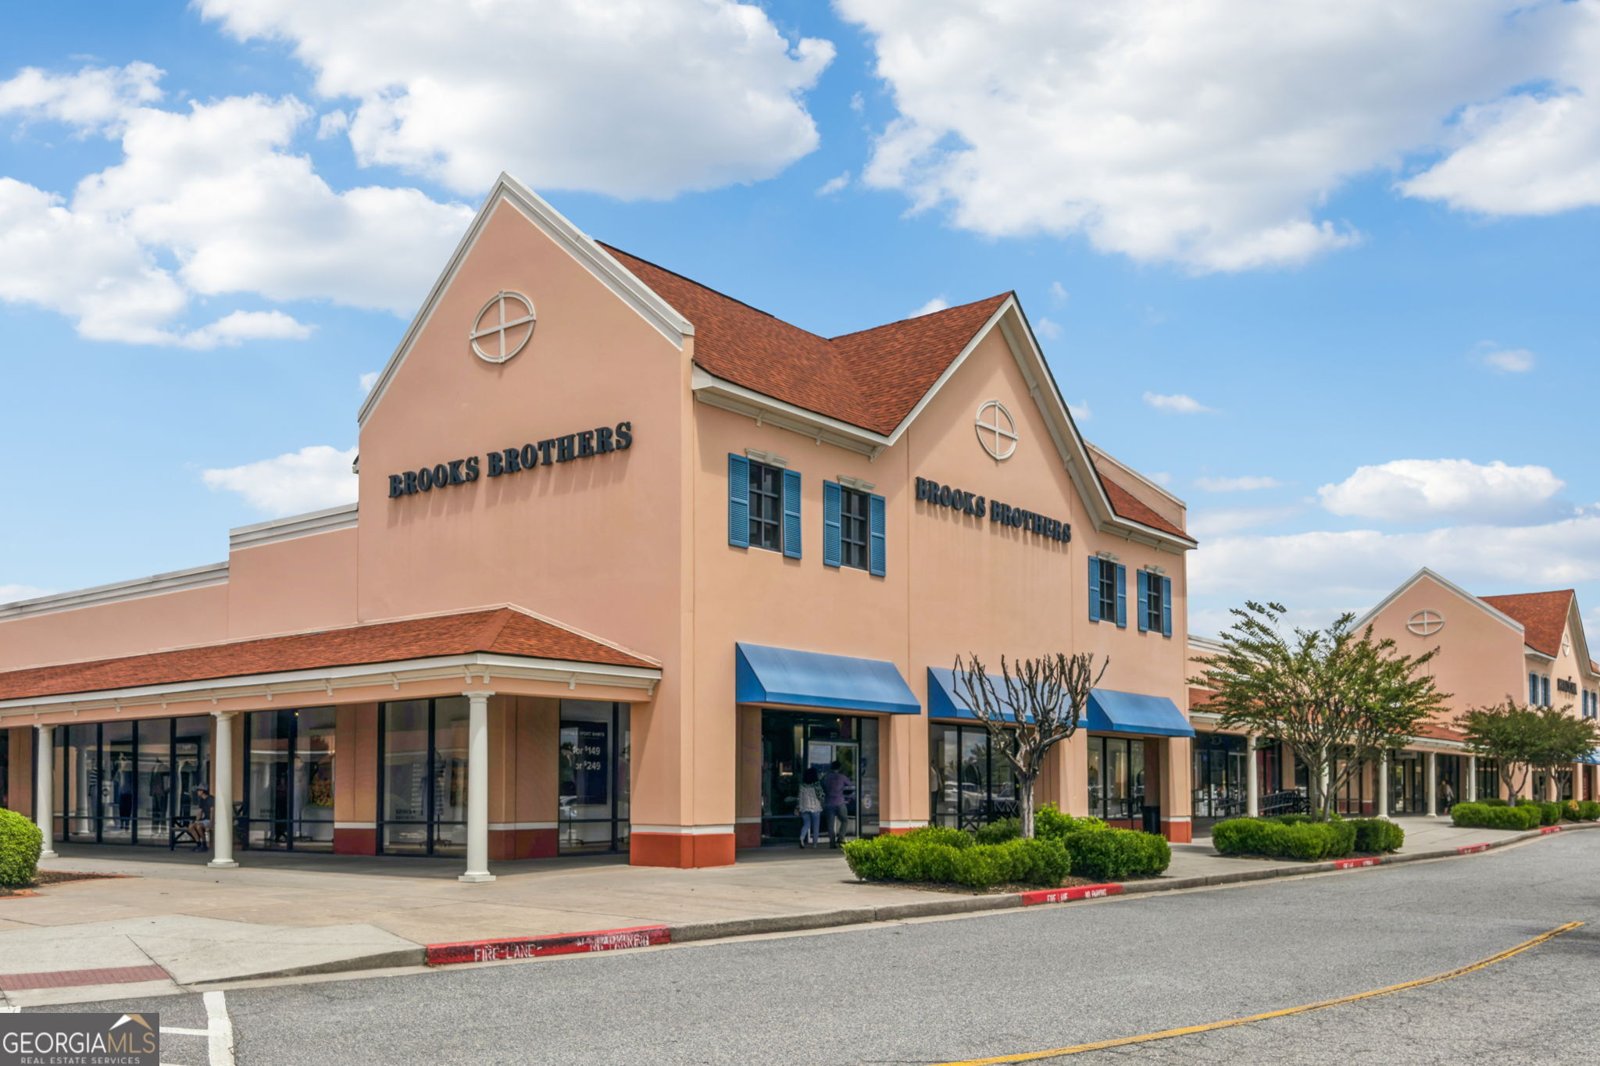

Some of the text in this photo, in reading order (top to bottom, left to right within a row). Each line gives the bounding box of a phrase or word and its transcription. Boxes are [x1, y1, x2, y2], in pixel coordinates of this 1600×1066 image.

[388, 421, 633, 498] BROOKS BROTHERS
[915, 476, 1071, 543] BROOKS BROTHERS
